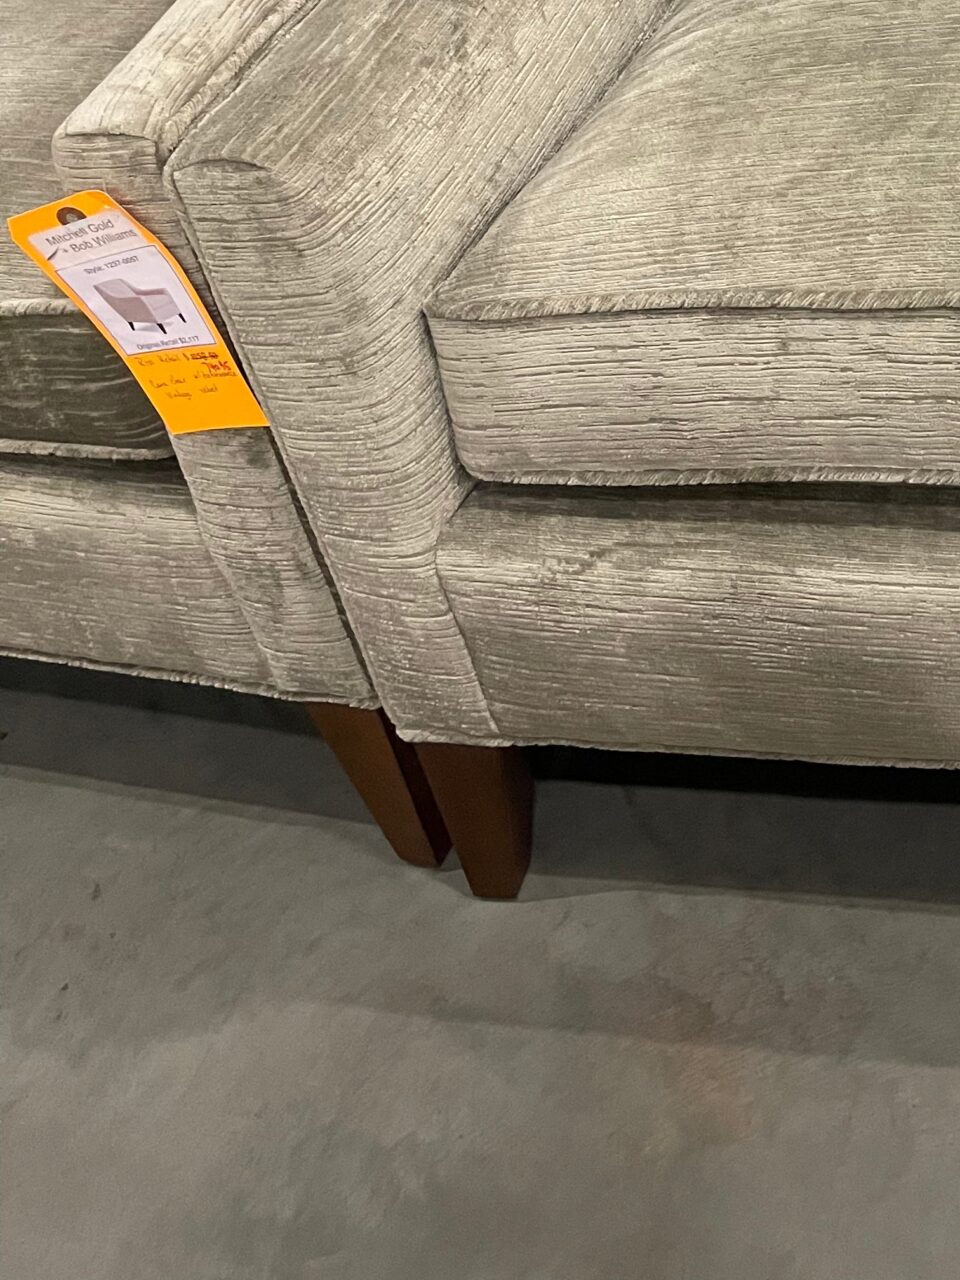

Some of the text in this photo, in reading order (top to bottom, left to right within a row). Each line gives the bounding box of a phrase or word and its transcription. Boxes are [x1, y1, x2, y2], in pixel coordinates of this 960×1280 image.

[45, 219, 115, 247] Mitchell Gold
[69, 240, 93, 253] Bob
[93, 228, 138, 247] Williams
